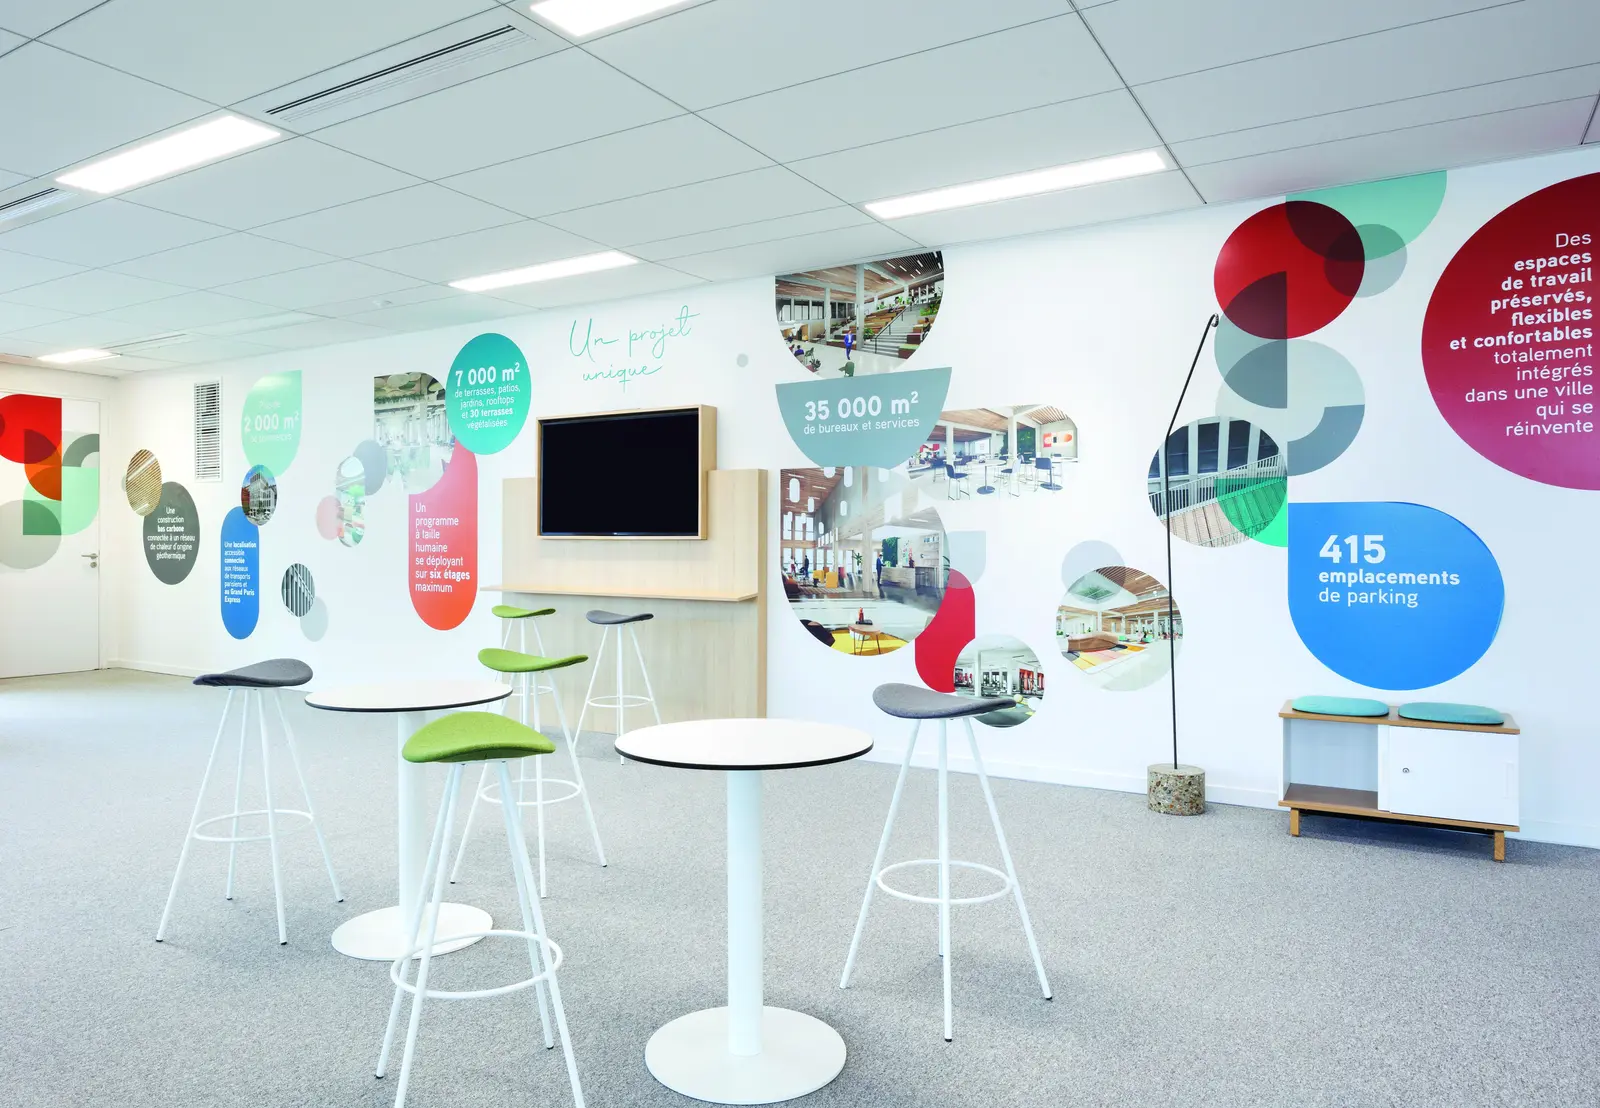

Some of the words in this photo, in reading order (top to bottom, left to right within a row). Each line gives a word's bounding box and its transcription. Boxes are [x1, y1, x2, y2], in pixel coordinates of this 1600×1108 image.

[1556, 233, 1591, 248] Des
[1514, 252, 1592, 272] espaces
[1502, 277, 1523, 291] de
[1530, 268, 1592, 287] travail
[1491, 288, 1592, 314] préservés,
[1512, 307, 1592, 326] flexibles
[570, 318, 619, 362] Un
[629, 305, 700, 359] projet
[1450, 337, 1466, 350] et
[1474, 326, 1592, 348] confortables
[1494, 344, 1592, 364] totalement
[456, 370, 463, 386] 7
[468, 366, 496, 385] 000
[502, 362, 520, 381] m²
[583, 364, 663, 393] unique
[1517, 363, 1592, 381] intégrés
[465, 387, 496, 397] terrasses,
[498, 384, 520, 393] patios,
[1465, 389, 1507, 402] dans
[1515, 387, 1548, 399] une
[1555, 381, 1593, 396] ville
[460, 400, 484, 410] jardins,
[487, 396, 514, 406] rooftops
[805, 400, 830, 421] 35
[838, 396, 882, 418] 000
[892, 391, 918, 414] m²
[1536, 401, 1564, 420] qui
[1572, 403, 1593, 414] se
[244, 416, 251, 432] 2
[255, 413, 278, 431] 000
[284, 411, 299, 430] m²
[470, 409, 479, 418] 30
[481, 408, 513, 416] terrasses
[467, 419, 507, 430] végétalisées
[804, 424, 815, 434] de
[819, 423, 858, 434] bureaux
[862, 421, 871, 430] et
[876, 417, 920, 429] services
[1506, 420, 1593, 436] réinvente
[416, 503, 426, 512] Un
[416, 518, 459, 528] programme
[416, 530, 419, 539] à
[422, 529, 440, 539] taille
[416, 542, 448, 552] humaine
[1319, 535, 1385, 564] 415
[426, 556, 463, 568] déployant
[430, 568, 441, 579] six
[444, 569, 470, 582] étages
[1319, 568, 1460, 587] emplacements
[416, 582, 452, 592] maximum
[1319, 588, 1340, 602] de
[1348, 588, 1418, 608] parking
